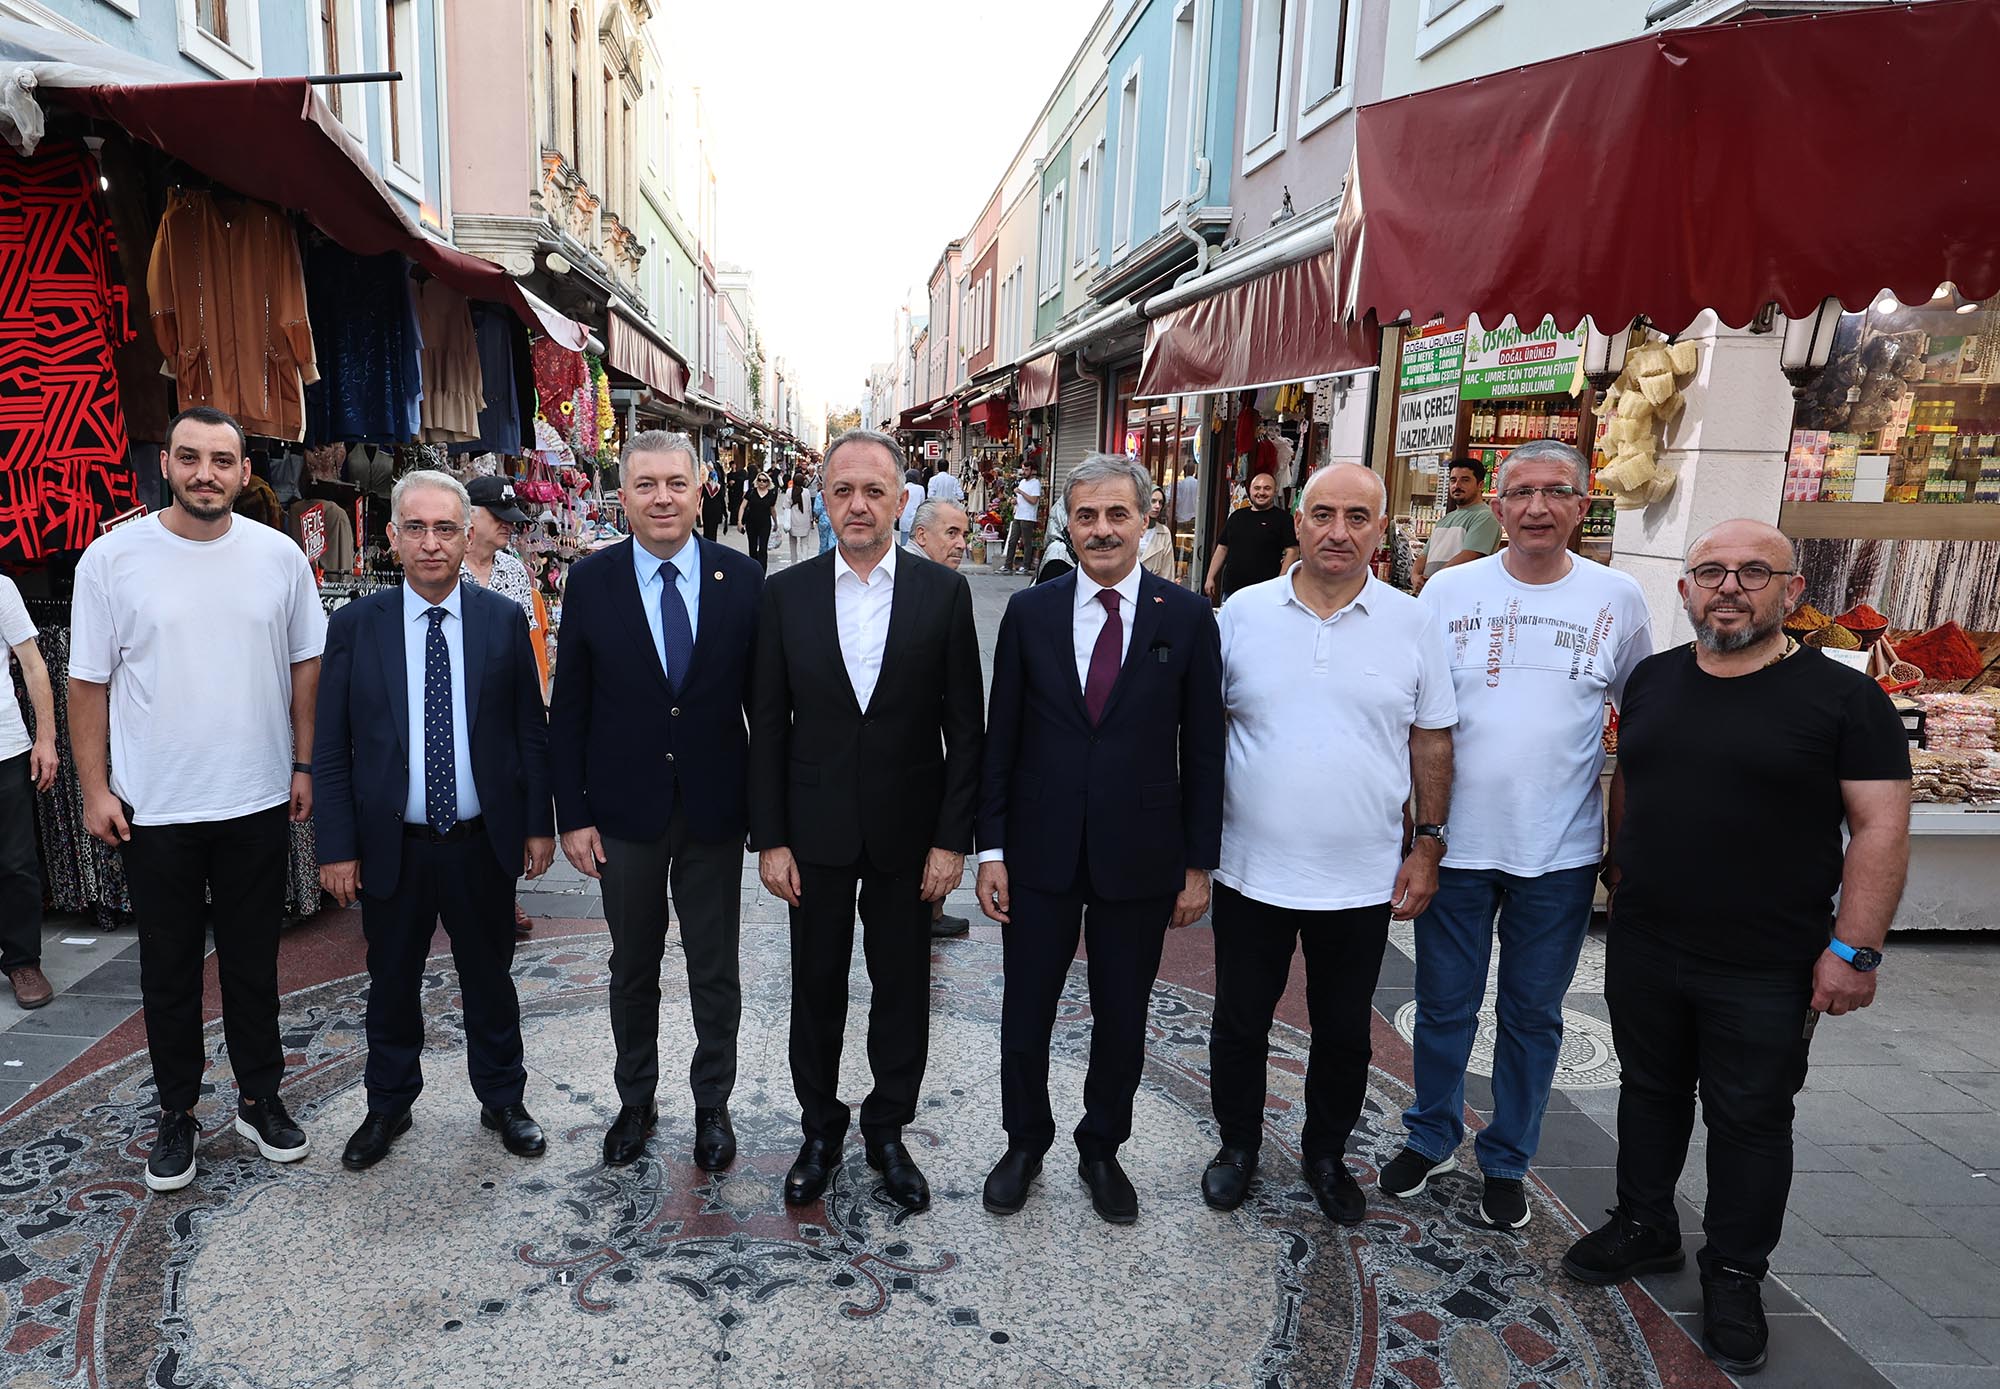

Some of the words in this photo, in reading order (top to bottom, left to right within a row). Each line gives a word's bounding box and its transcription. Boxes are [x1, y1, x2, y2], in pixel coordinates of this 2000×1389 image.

[1404, 341, 1428, 354] DOĞAL
[1428, 333, 1464, 348] ÜRÜNLER
[1482, 327, 1522, 353] OSMAN
[1500, 349, 1523, 365] DOĞAL
[1524, 346, 1555, 360] ÜRÜNLER
[1464, 373, 1480, 385] HAC
[1485, 370, 1507, 384] UMRE
[1507, 365, 1524, 385] İÇİN
[1524, 363, 1552, 381] TOPTAN
[1552, 360, 1577, 376] FİYATI
[1491, 384, 1519, 397] HURMA
[1520, 380, 1556, 395] BULUNUR
[1400, 401, 1422, 423] KINA
[1424, 388, 1457, 425] ÇEREZİ
[1400, 424, 1454, 450] HAZIRLANIR
[1448, 617, 1482, 634] BRAIN
[1601, 613, 1614, 641] new
[1583, 657, 1594, 677] The
